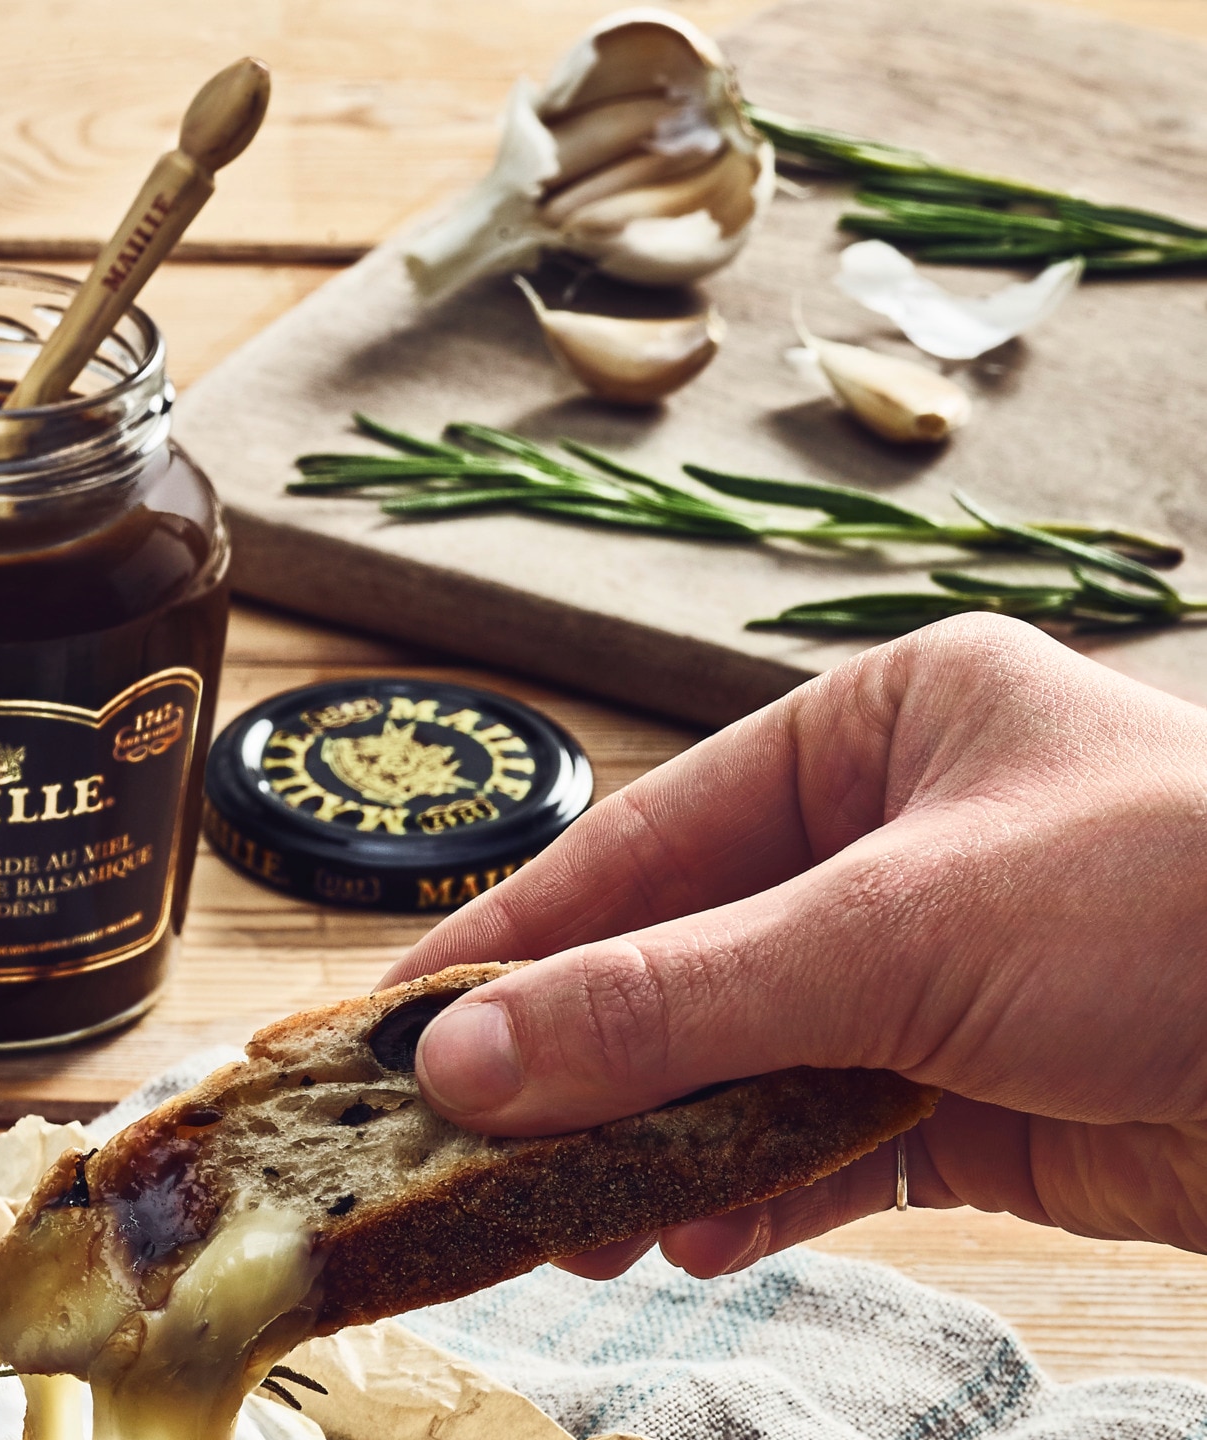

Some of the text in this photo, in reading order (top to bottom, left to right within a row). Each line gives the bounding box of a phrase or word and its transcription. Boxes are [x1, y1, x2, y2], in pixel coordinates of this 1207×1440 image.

[102, 193, 175, 291] MAILLE
[263, 730, 410, 835] MAILLE
[388, 696, 536, 800] MAILLE
[16, 843, 154, 896] BALSAMIQUE
[45, 849, 77, 870] AU
[83, 833, 135, 864] MIEL
[417, 857, 531, 908] MAI
